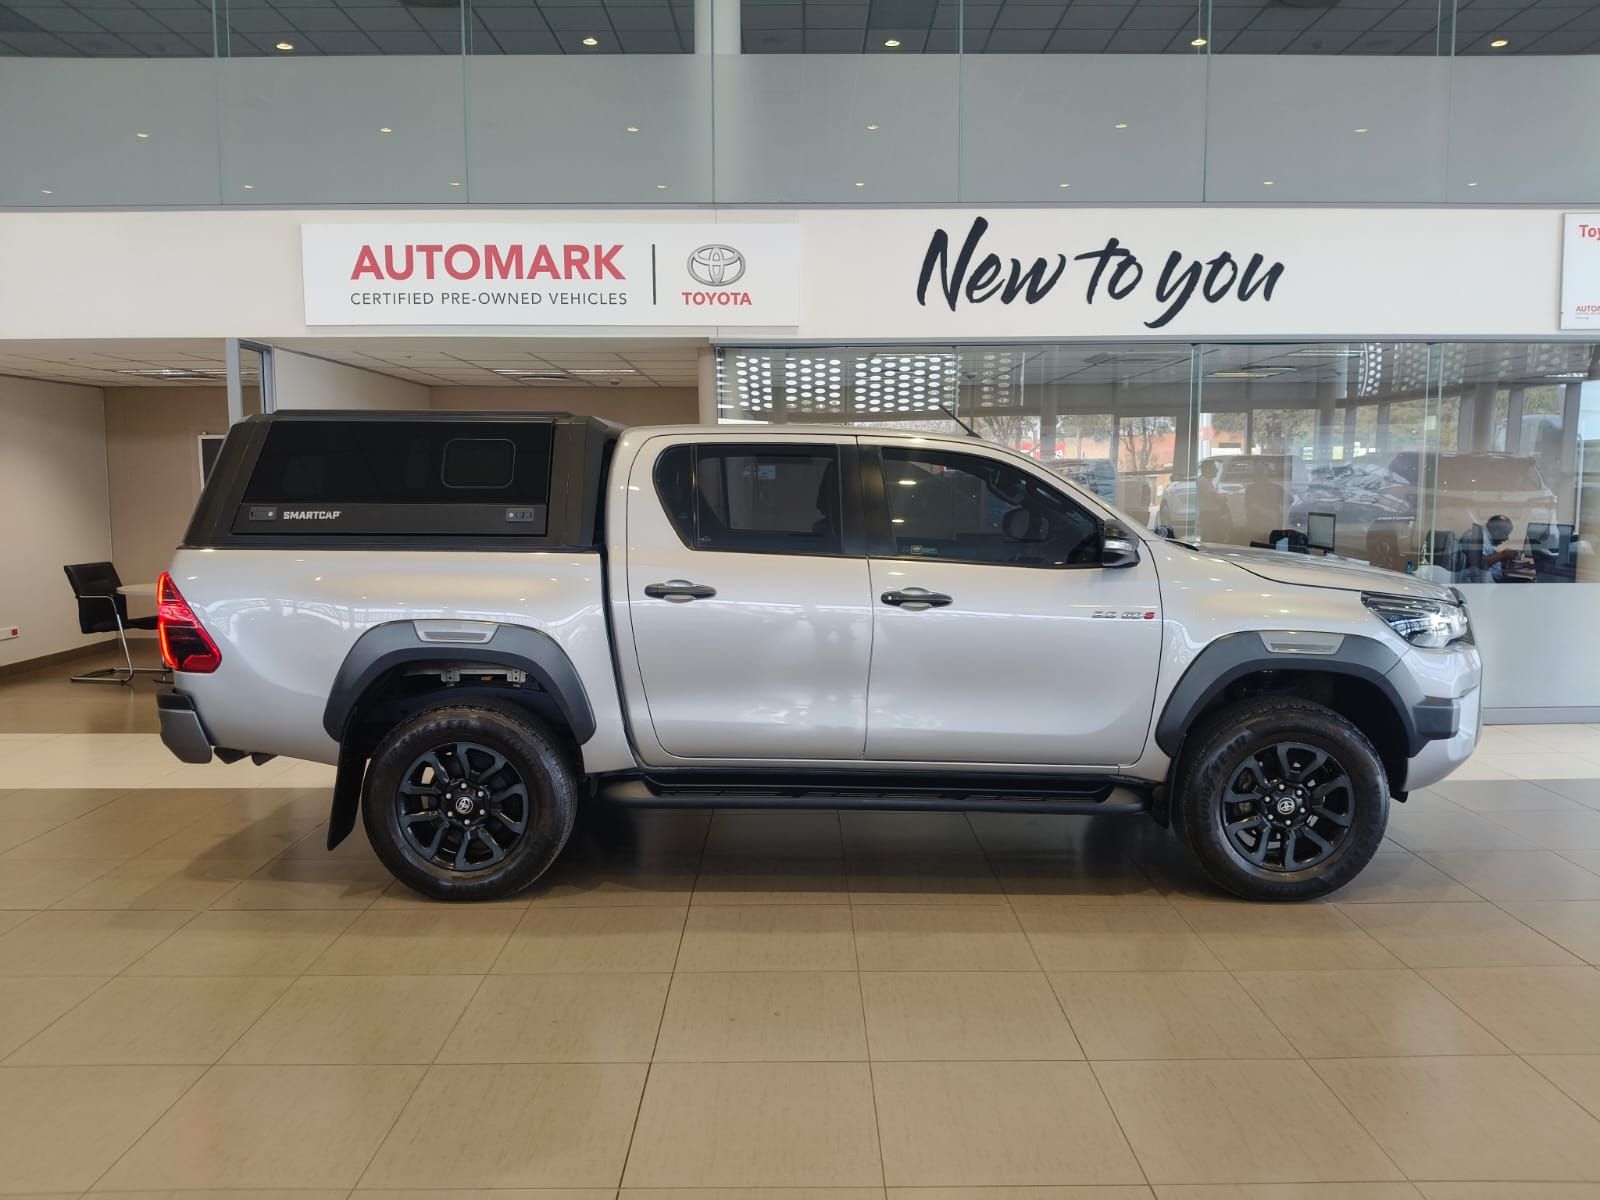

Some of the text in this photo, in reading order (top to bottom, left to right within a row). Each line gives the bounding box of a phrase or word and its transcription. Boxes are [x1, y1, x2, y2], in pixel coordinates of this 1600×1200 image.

[351, 244, 626, 280] AUTOMARK
[917, 217, 1284, 328] New to you
[350, 292, 627, 305] CERTIFIED PRE-OWNED VEHICLES
[682, 292, 752, 306] TOYOTA
[283, 511, 341, 520] SMARTCAP
